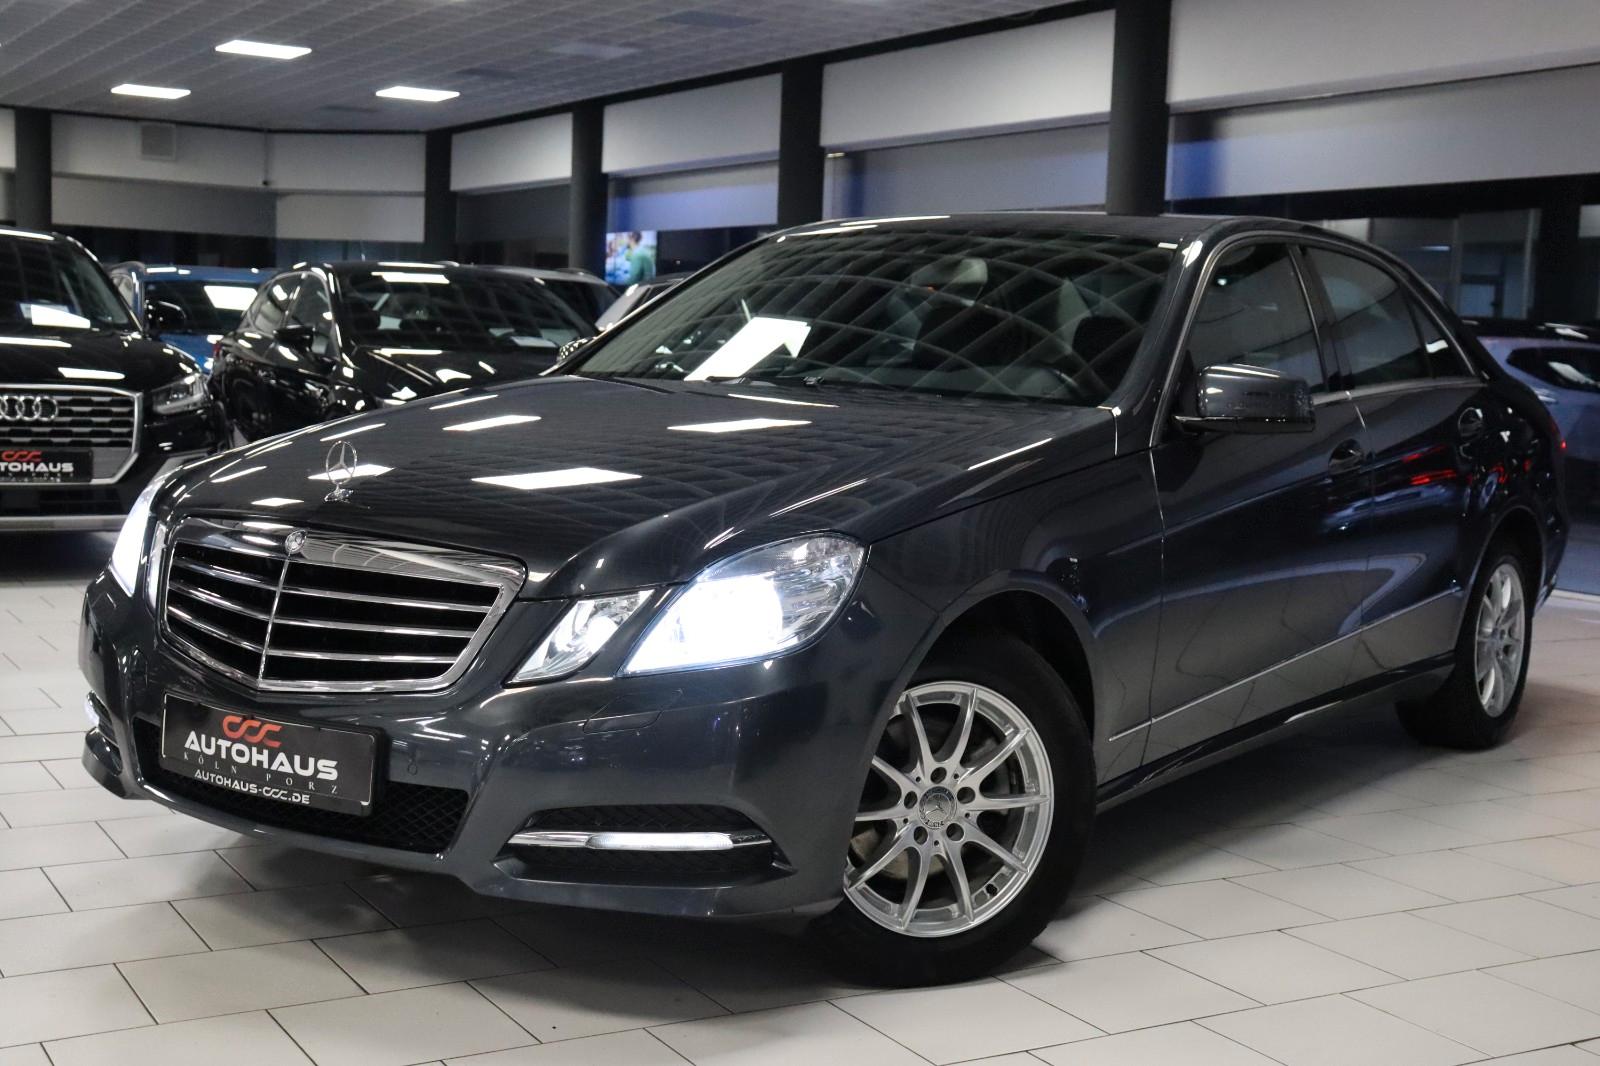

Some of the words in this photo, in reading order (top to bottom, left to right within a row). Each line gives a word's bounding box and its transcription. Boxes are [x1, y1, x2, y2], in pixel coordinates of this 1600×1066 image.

[0, 462, 74, 473] TOHAUS
[184, 730, 338, 780] AUTOHAUS
[194, 769, 310, 805] AUTOHAUS-CCC.DE
[266, 773, 338, 794] PORZ
